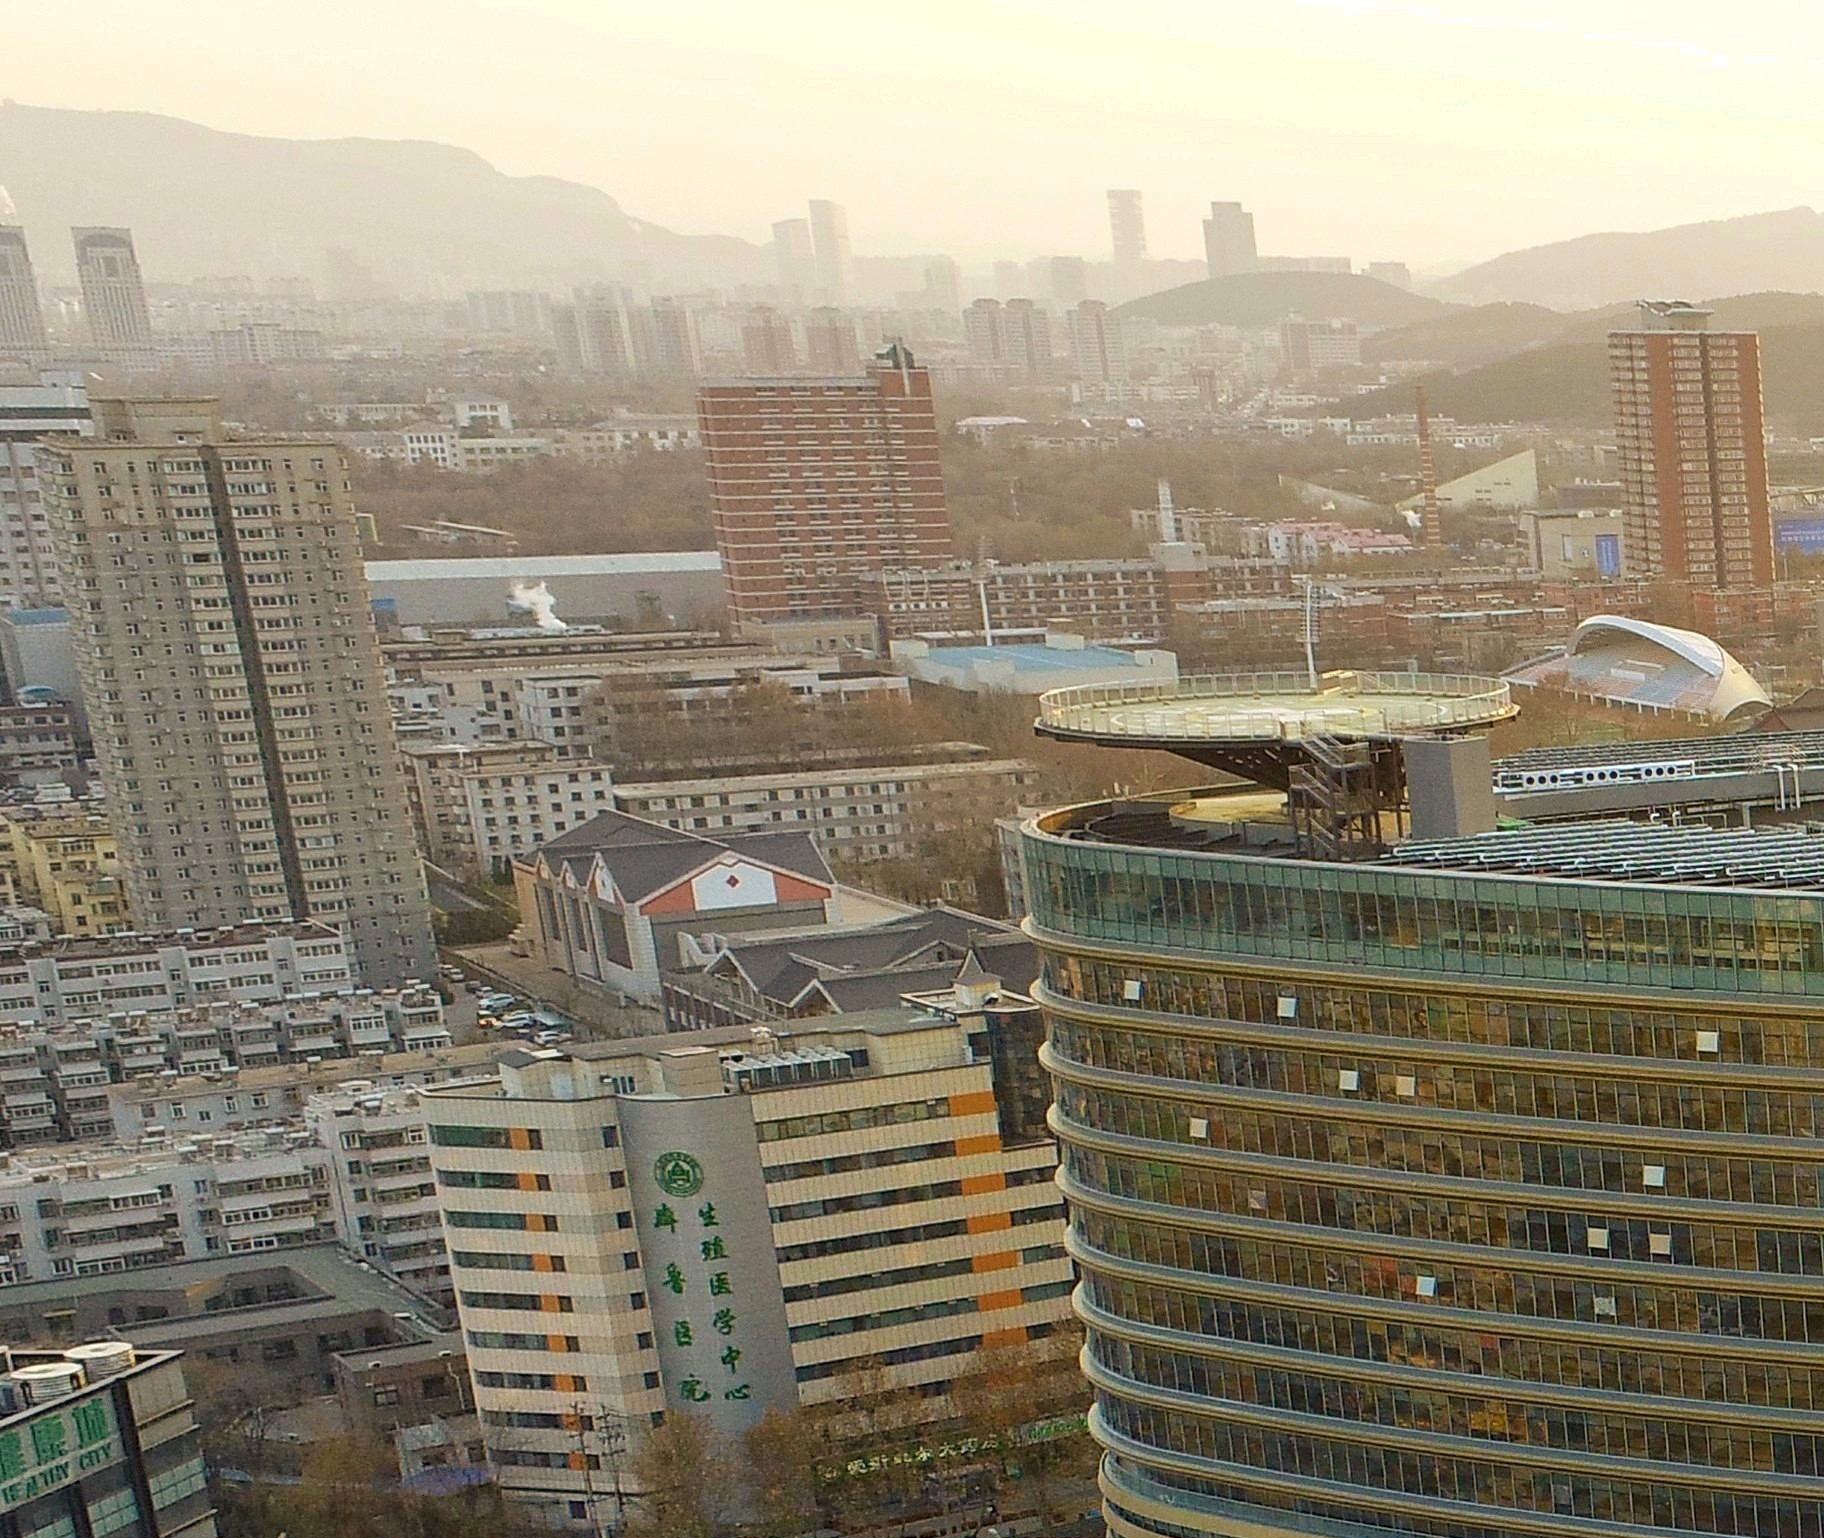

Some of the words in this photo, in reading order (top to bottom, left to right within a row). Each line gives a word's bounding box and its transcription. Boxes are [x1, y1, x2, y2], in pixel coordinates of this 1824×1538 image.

[699, 1202, 750, 1400] 生殖医学中心
[79, 1441, 112, 1471] CITY
